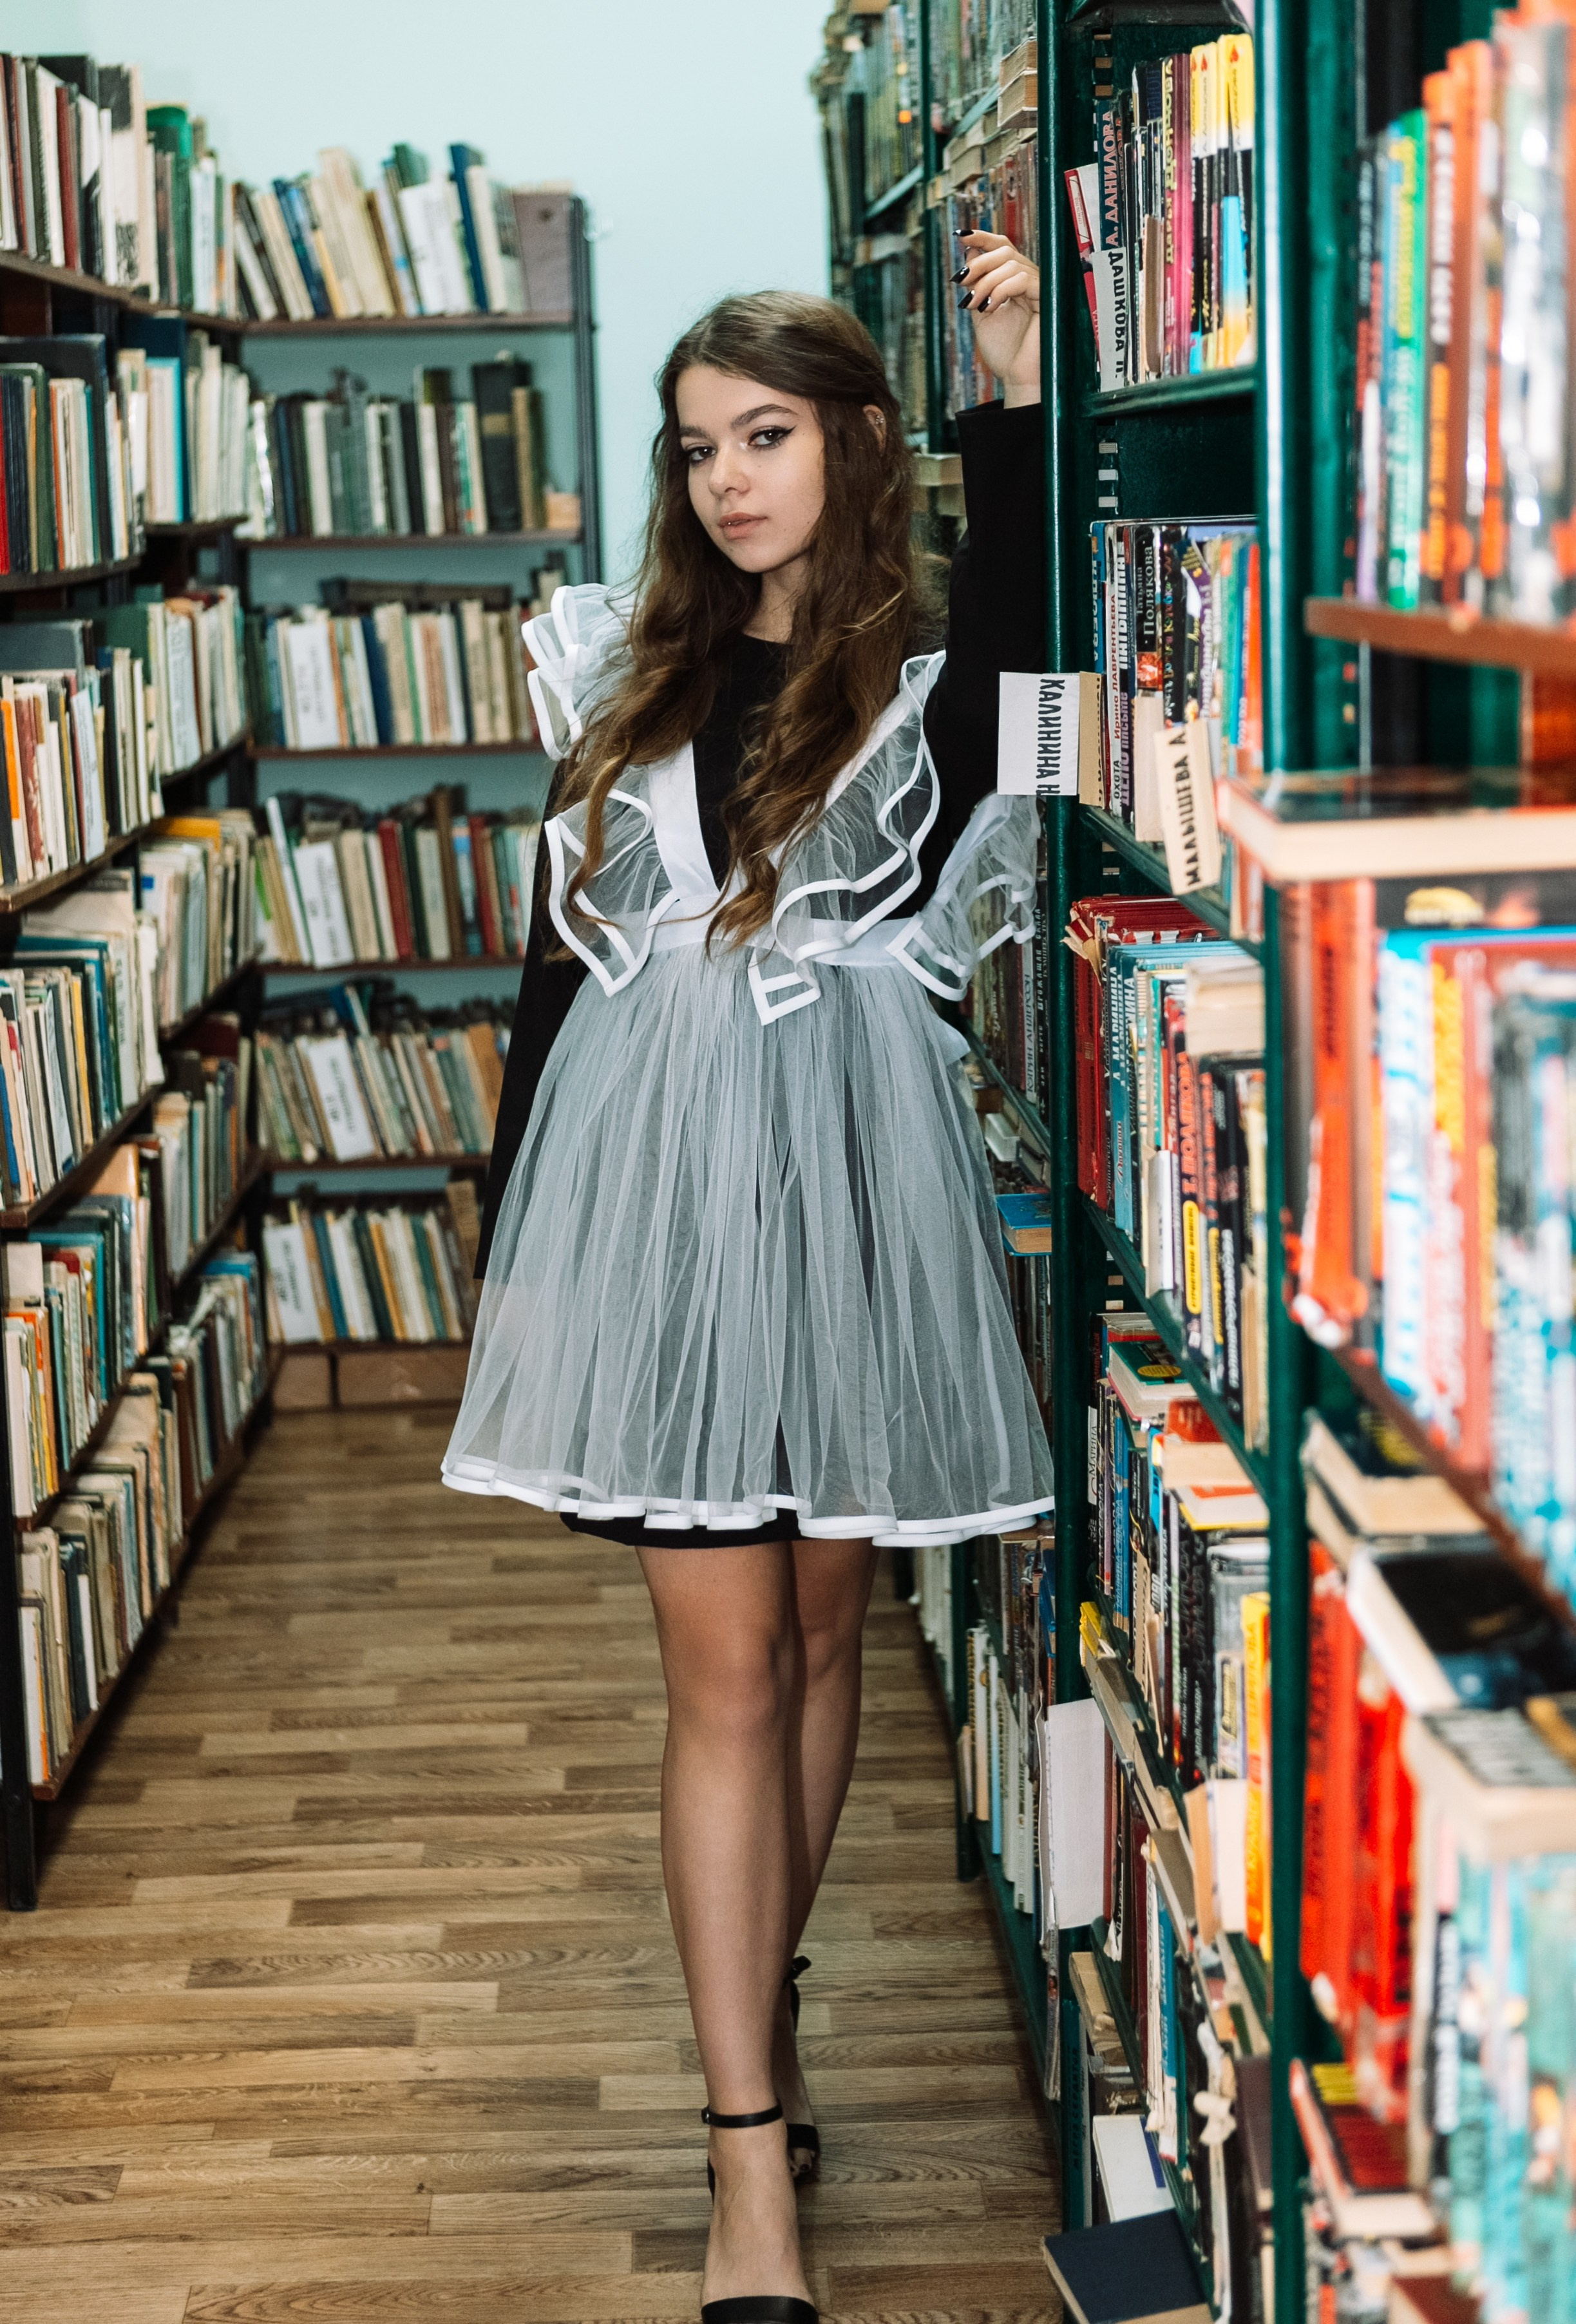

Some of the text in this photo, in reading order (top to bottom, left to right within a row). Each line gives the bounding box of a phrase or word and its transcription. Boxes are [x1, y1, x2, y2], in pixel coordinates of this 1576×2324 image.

[1102, 111, 1119, 247] А. ДАНИЛОВА
[1108, 251, 1125, 352] ДАШКОВА
[1144, 546, 1154, 636] Полякова
[1036, 678, 1066, 779] КАЛИНИНА
[1173, 755, 1201, 887] МАЛЫШЕВА
[1110, 967, 1119, 1061] МАРИНИНА
